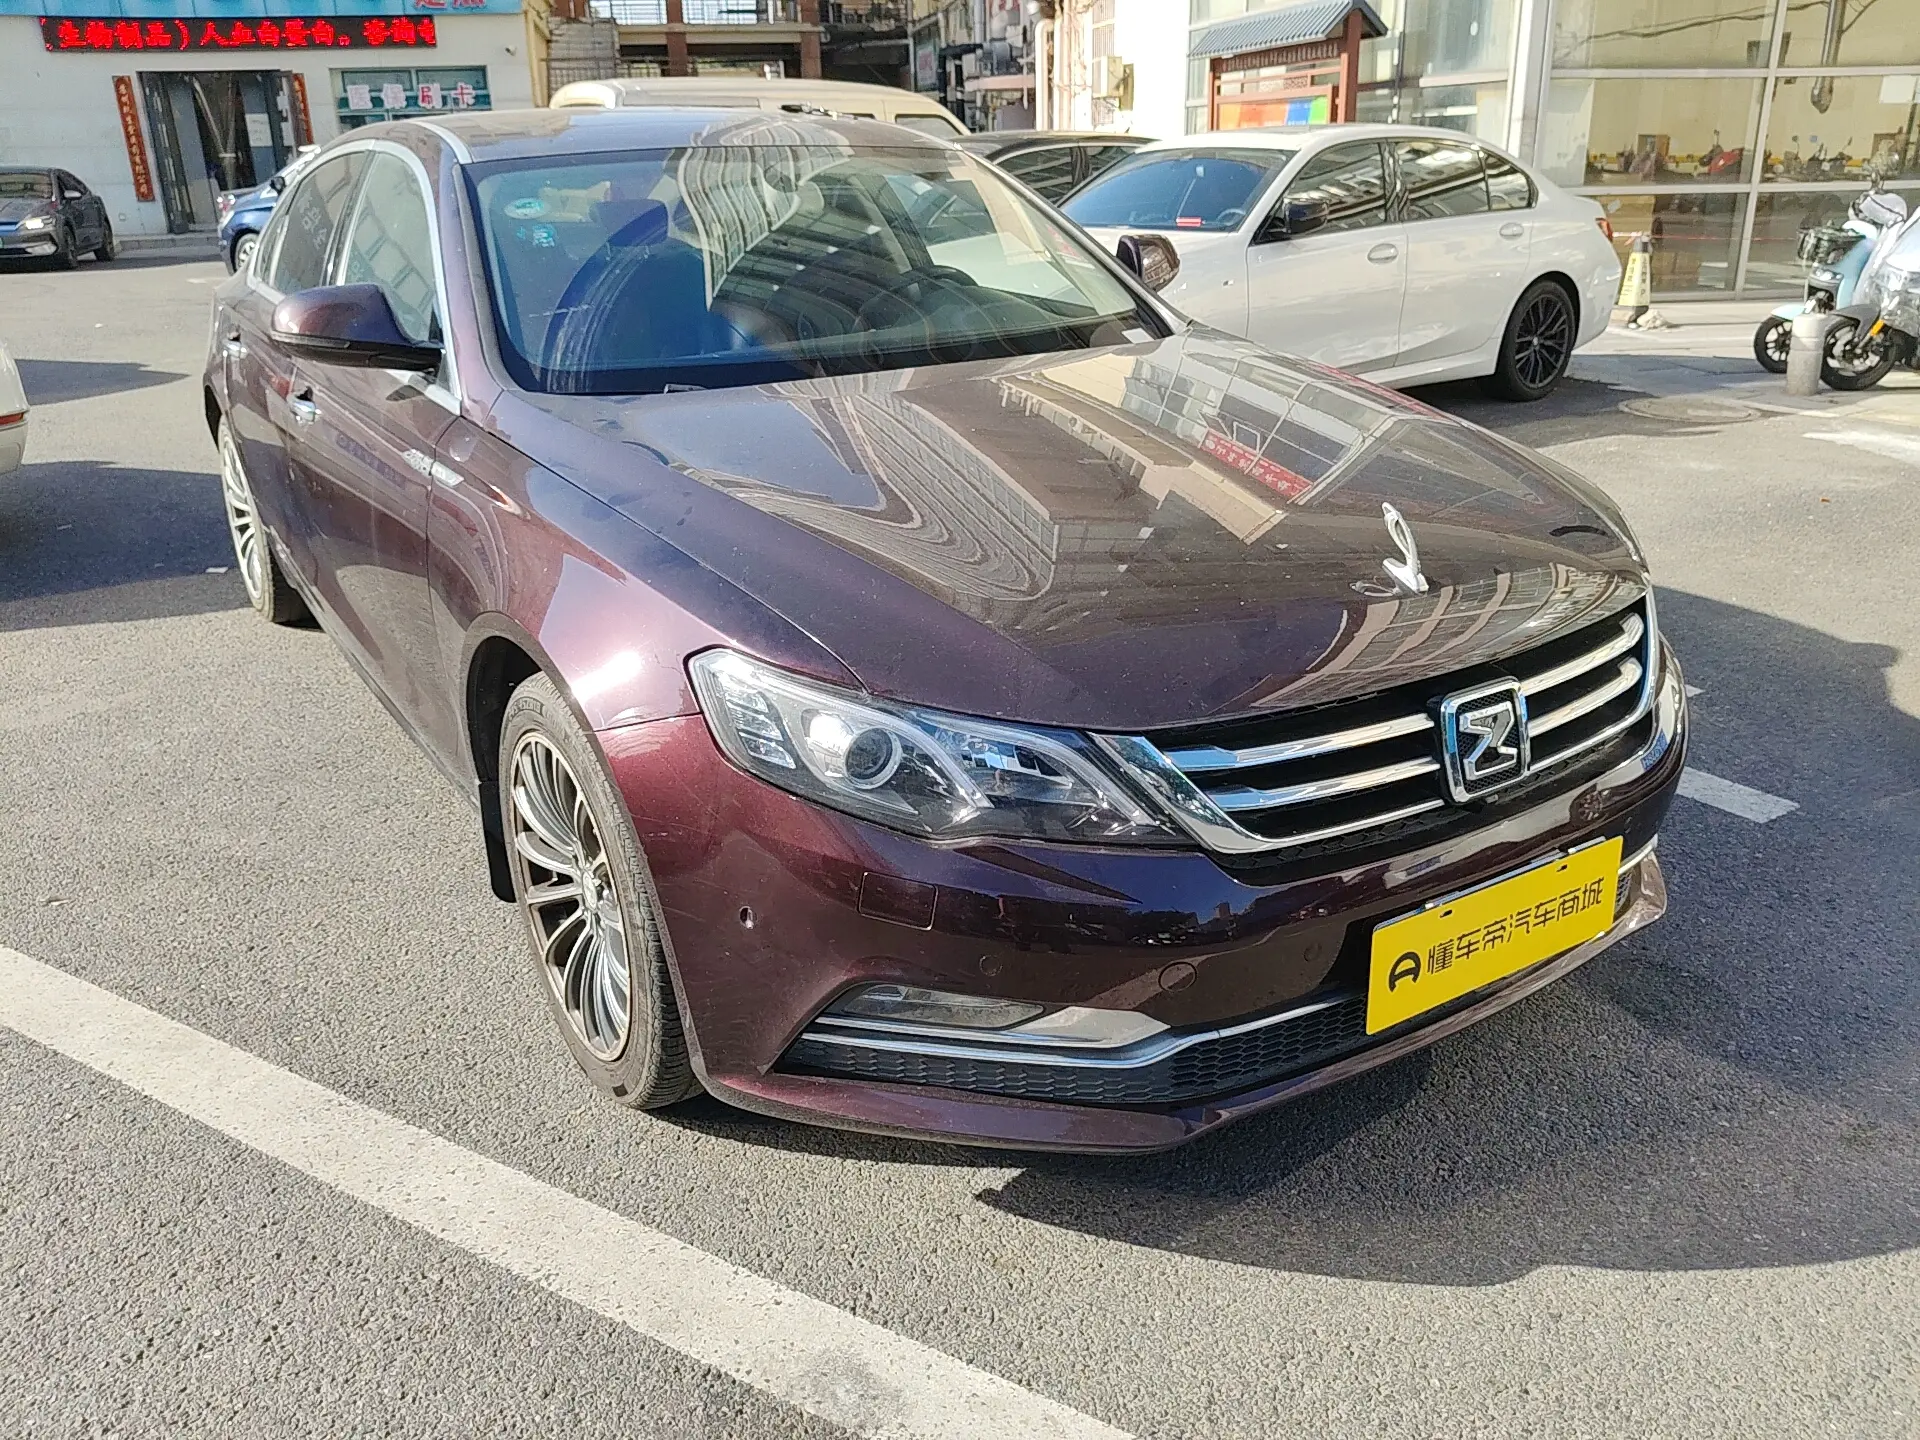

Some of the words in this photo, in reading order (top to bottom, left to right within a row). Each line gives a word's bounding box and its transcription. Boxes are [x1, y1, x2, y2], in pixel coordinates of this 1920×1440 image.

[1427, 876, 1605, 975] 懂车帝汽车商城
